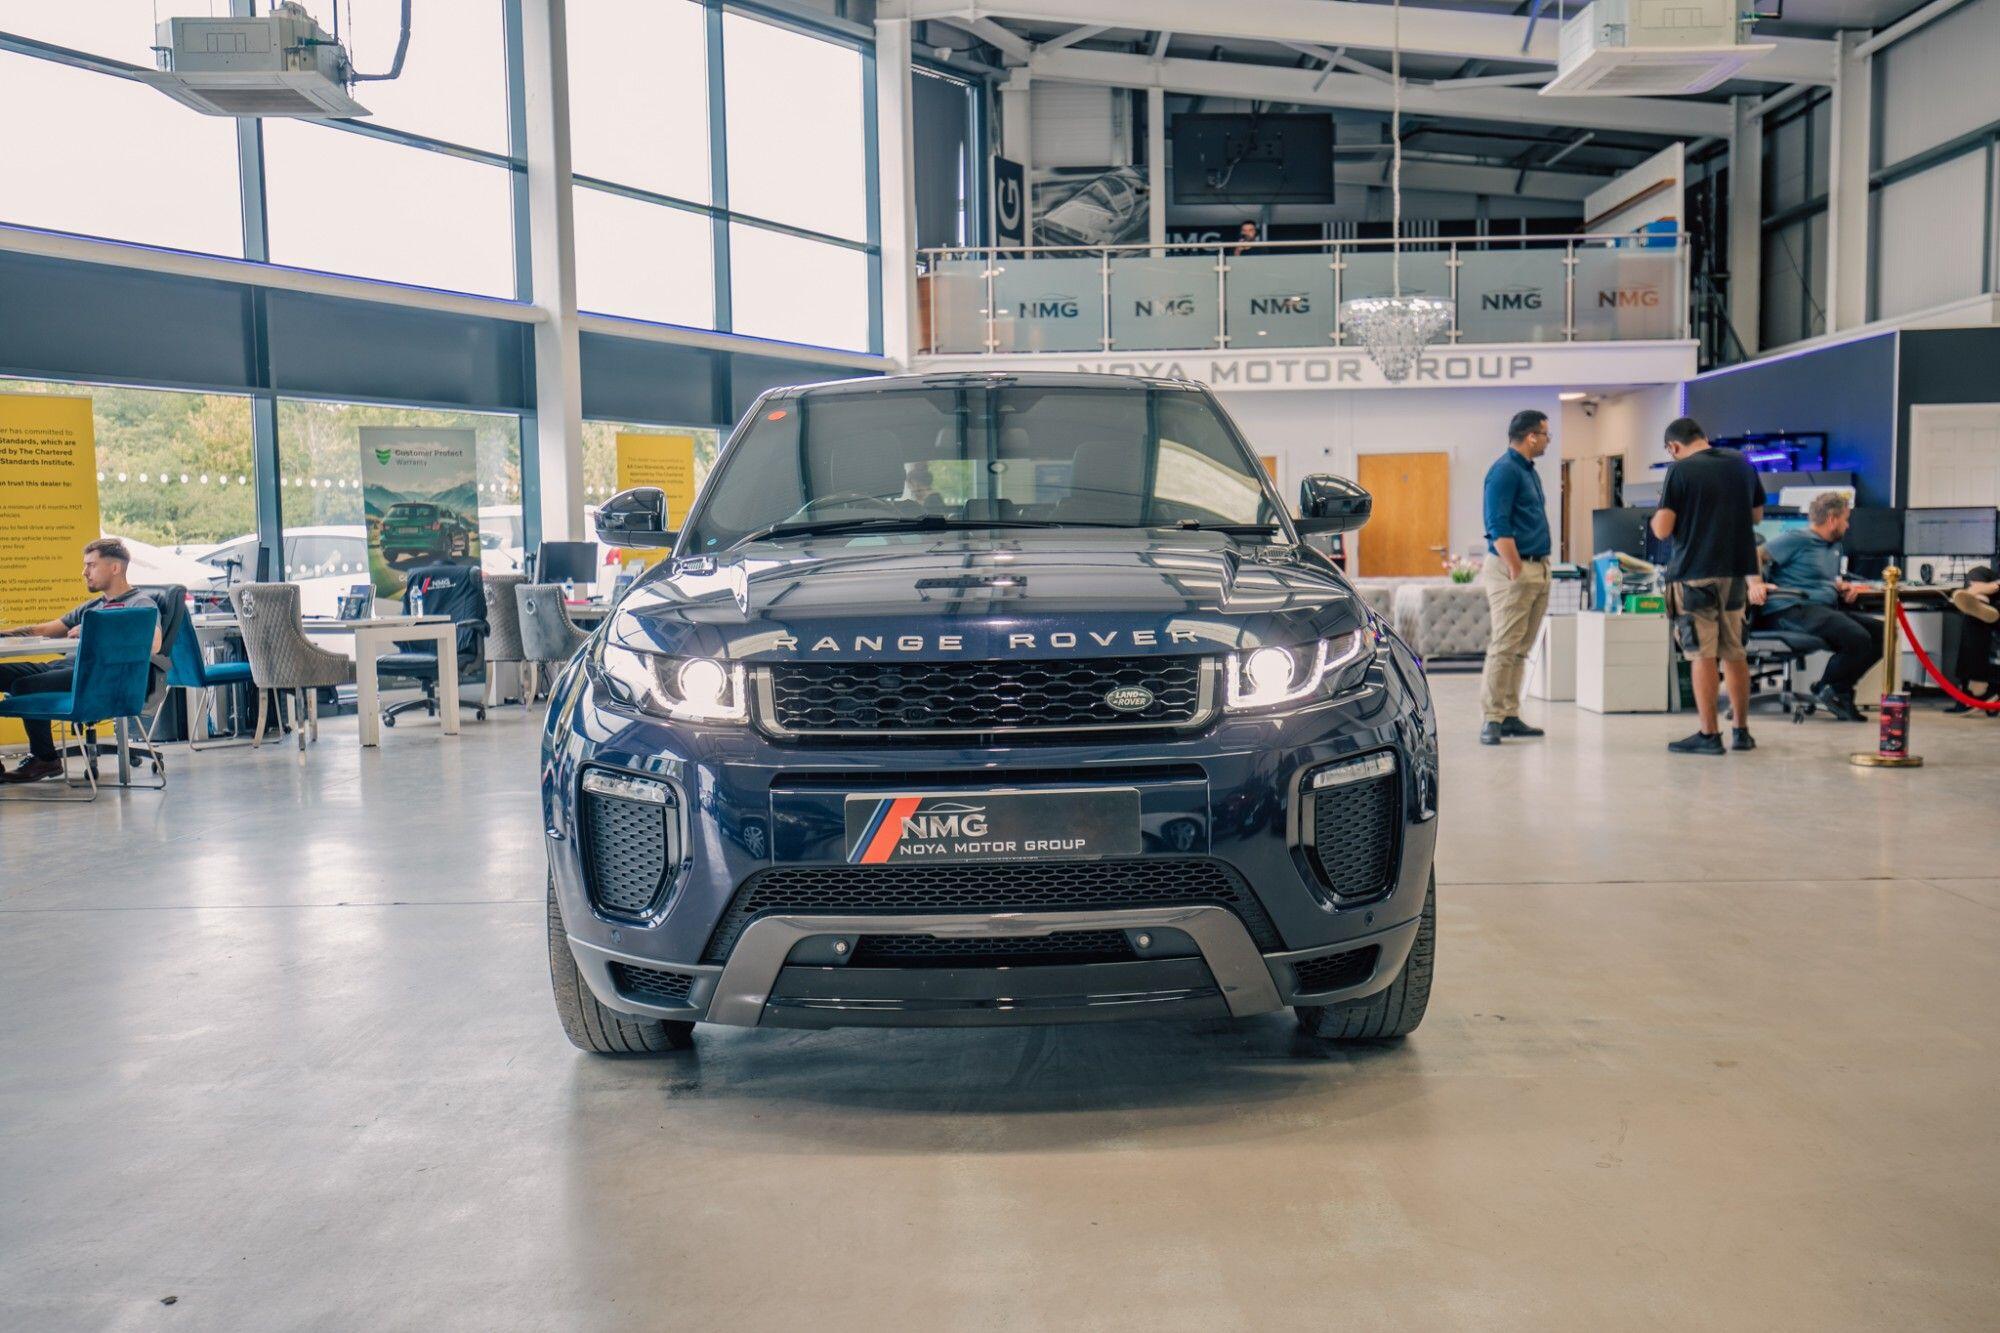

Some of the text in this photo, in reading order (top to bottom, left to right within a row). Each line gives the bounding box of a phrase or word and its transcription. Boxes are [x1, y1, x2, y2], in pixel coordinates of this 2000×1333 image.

[1251, 298, 1310, 315] NMG
[1482, 293, 1543, 310] NMG
[1599, 290, 1660, 308] NMG
[1020, 302, 1079, 318] NMG
[1135, 300, 1195, 317] NMG
[1211, 358, 1363, 384] MOTOR
[9, 427, 22, 435] has
[24, 428, 64, 436] committed
[40, 438, 63, 446] which
[8, 447, 17, 456] by
[35, 448, 73, 456] Chartered
[395, 448, 464, 458] Customer Protect
[0, 457, 40, 466] Standards
[395, 459, 428, 467] Warranty
[773, 630, 1199, 652] RANGE ROVER
[1115, 691, 1139, 699] LAND
[1118, 697, 1147, 706] ROVER
[900, 813, 988, 840] NMG
[900, 838, 1087, 855] NOYA MOTOR GROUP
